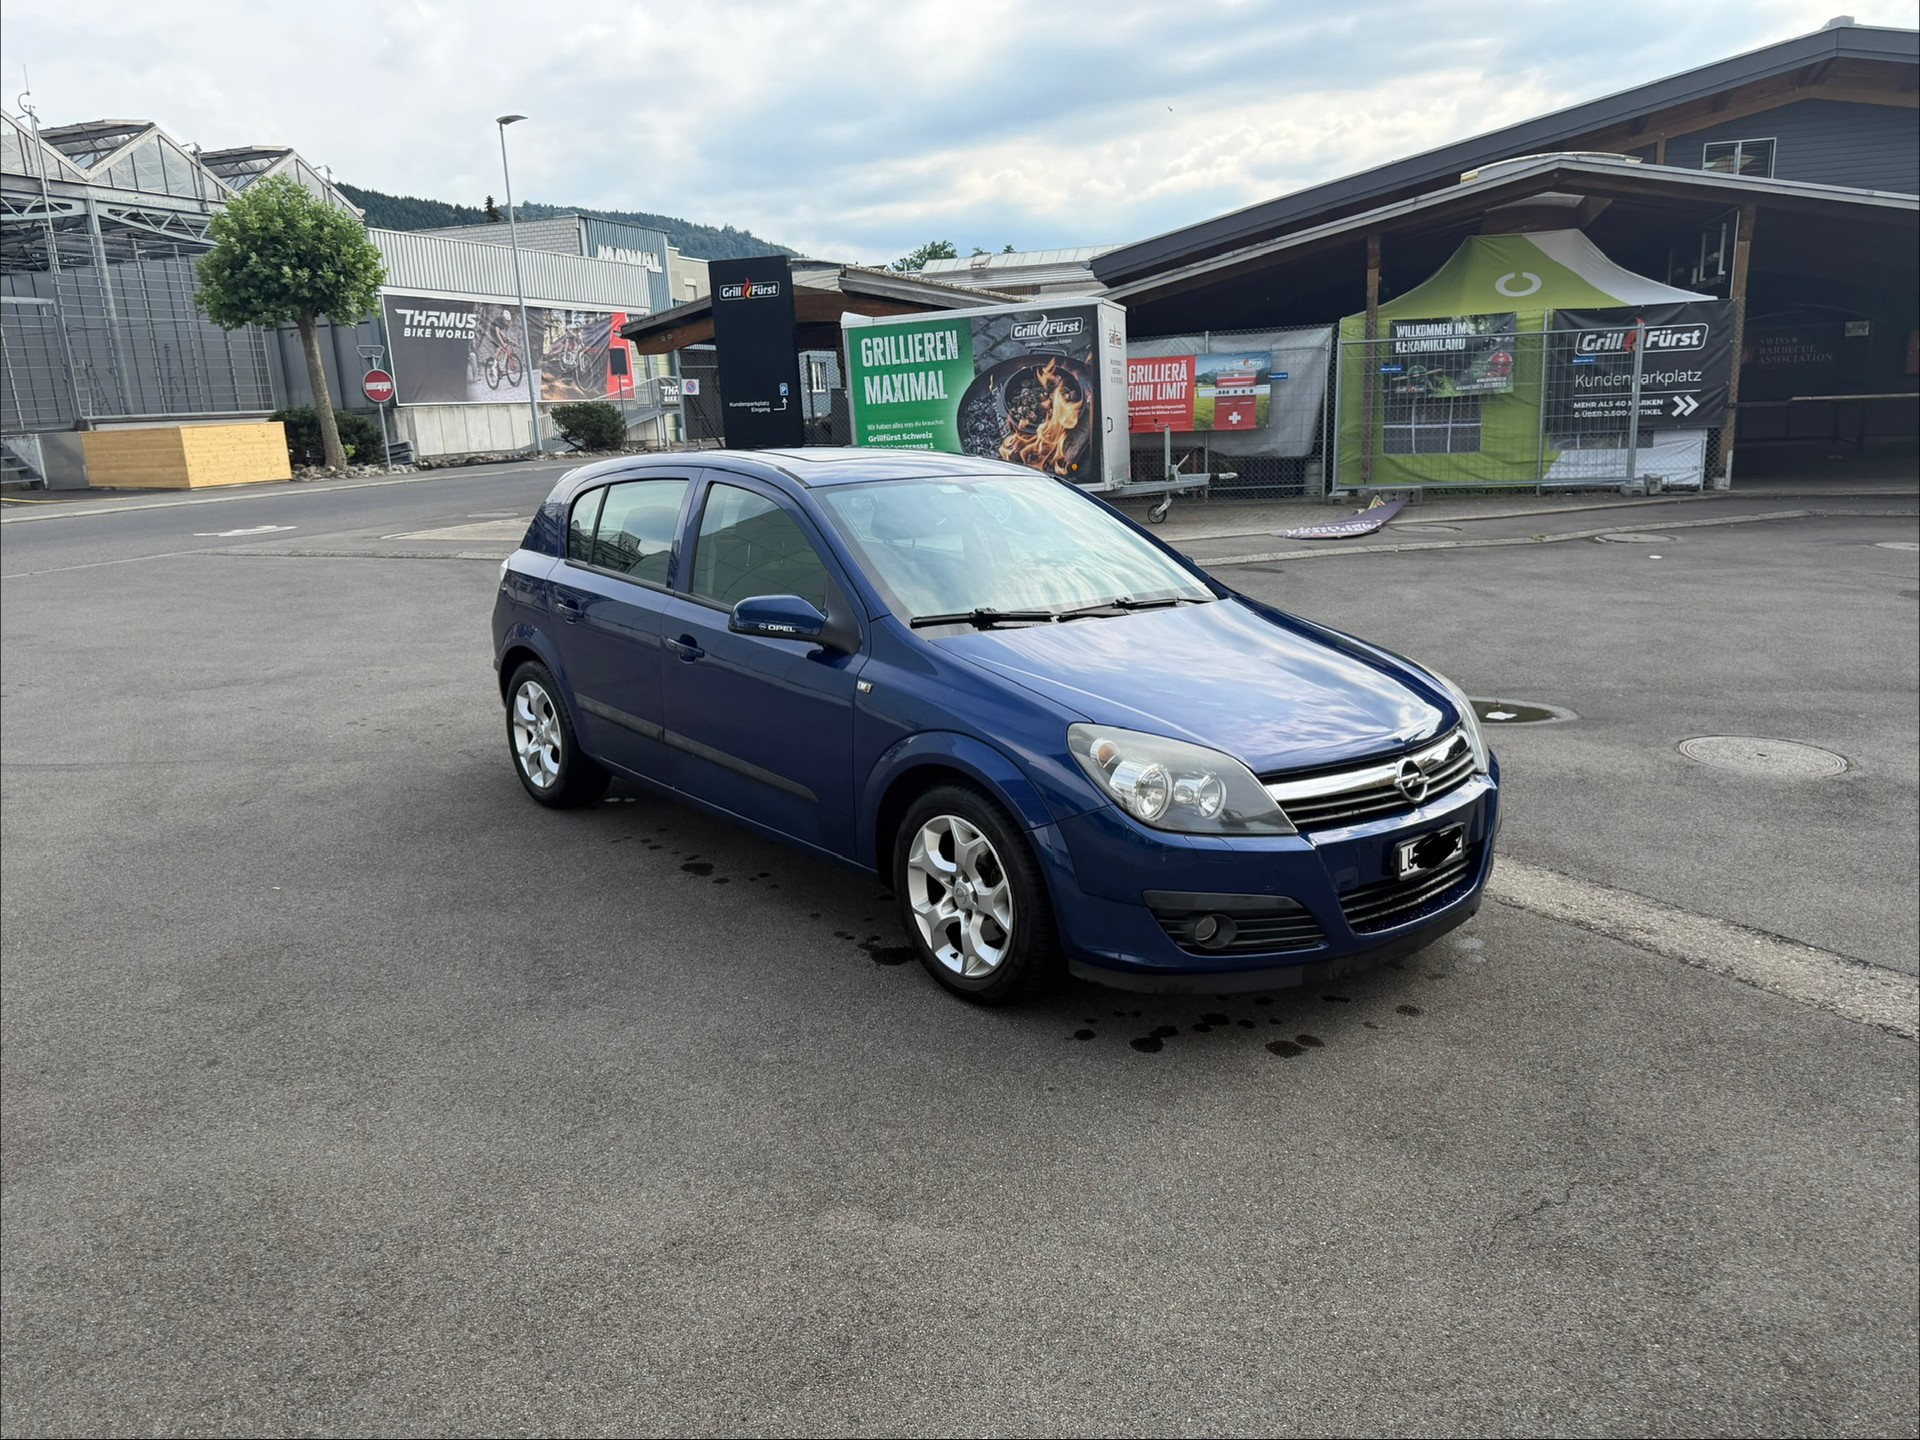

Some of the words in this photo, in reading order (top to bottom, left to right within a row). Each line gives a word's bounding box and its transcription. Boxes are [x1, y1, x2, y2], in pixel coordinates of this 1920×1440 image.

[722, 286, 742, 297] Grill
[752, 285, 777, 295] Fürst
[404, 327, 432, 338] BIKE
[435, 329, 475, 339] WORLD
[1014, 324, 1037, 337] Grill
[1049, 321, 1079, 334] Fürst
[1396, 323, 1453, 338] WILLKOMMEN
[1455, 322, 1466, 335] IM
[1395, 338, 1466, 353] KERAMIKLAND
[1582, 332, 1624, 350] Grill
[1645, 330, 1701, 348] Fürst
[860, 330, 959, 367] GRILLIEREN
[1759, 345, 1817, 355] BARBECUE
[1758, 352, 1833, 365] ASSOCIATION
[1128, 360, 1188, 383] GRILLIERÄ
[1575, 369, 1702, 388] Kundenarkplatz
[864, 370, 948, 405] MAXIMAL
[1128, 385, 1153, 402] OHNI
[1157, 382, 1188, 400] LIMIT
[868, 433, 902, 443] Grillfürst
[902, 431, 933, 440] Schweiz
[767, 624, 796, 633] OPEL
